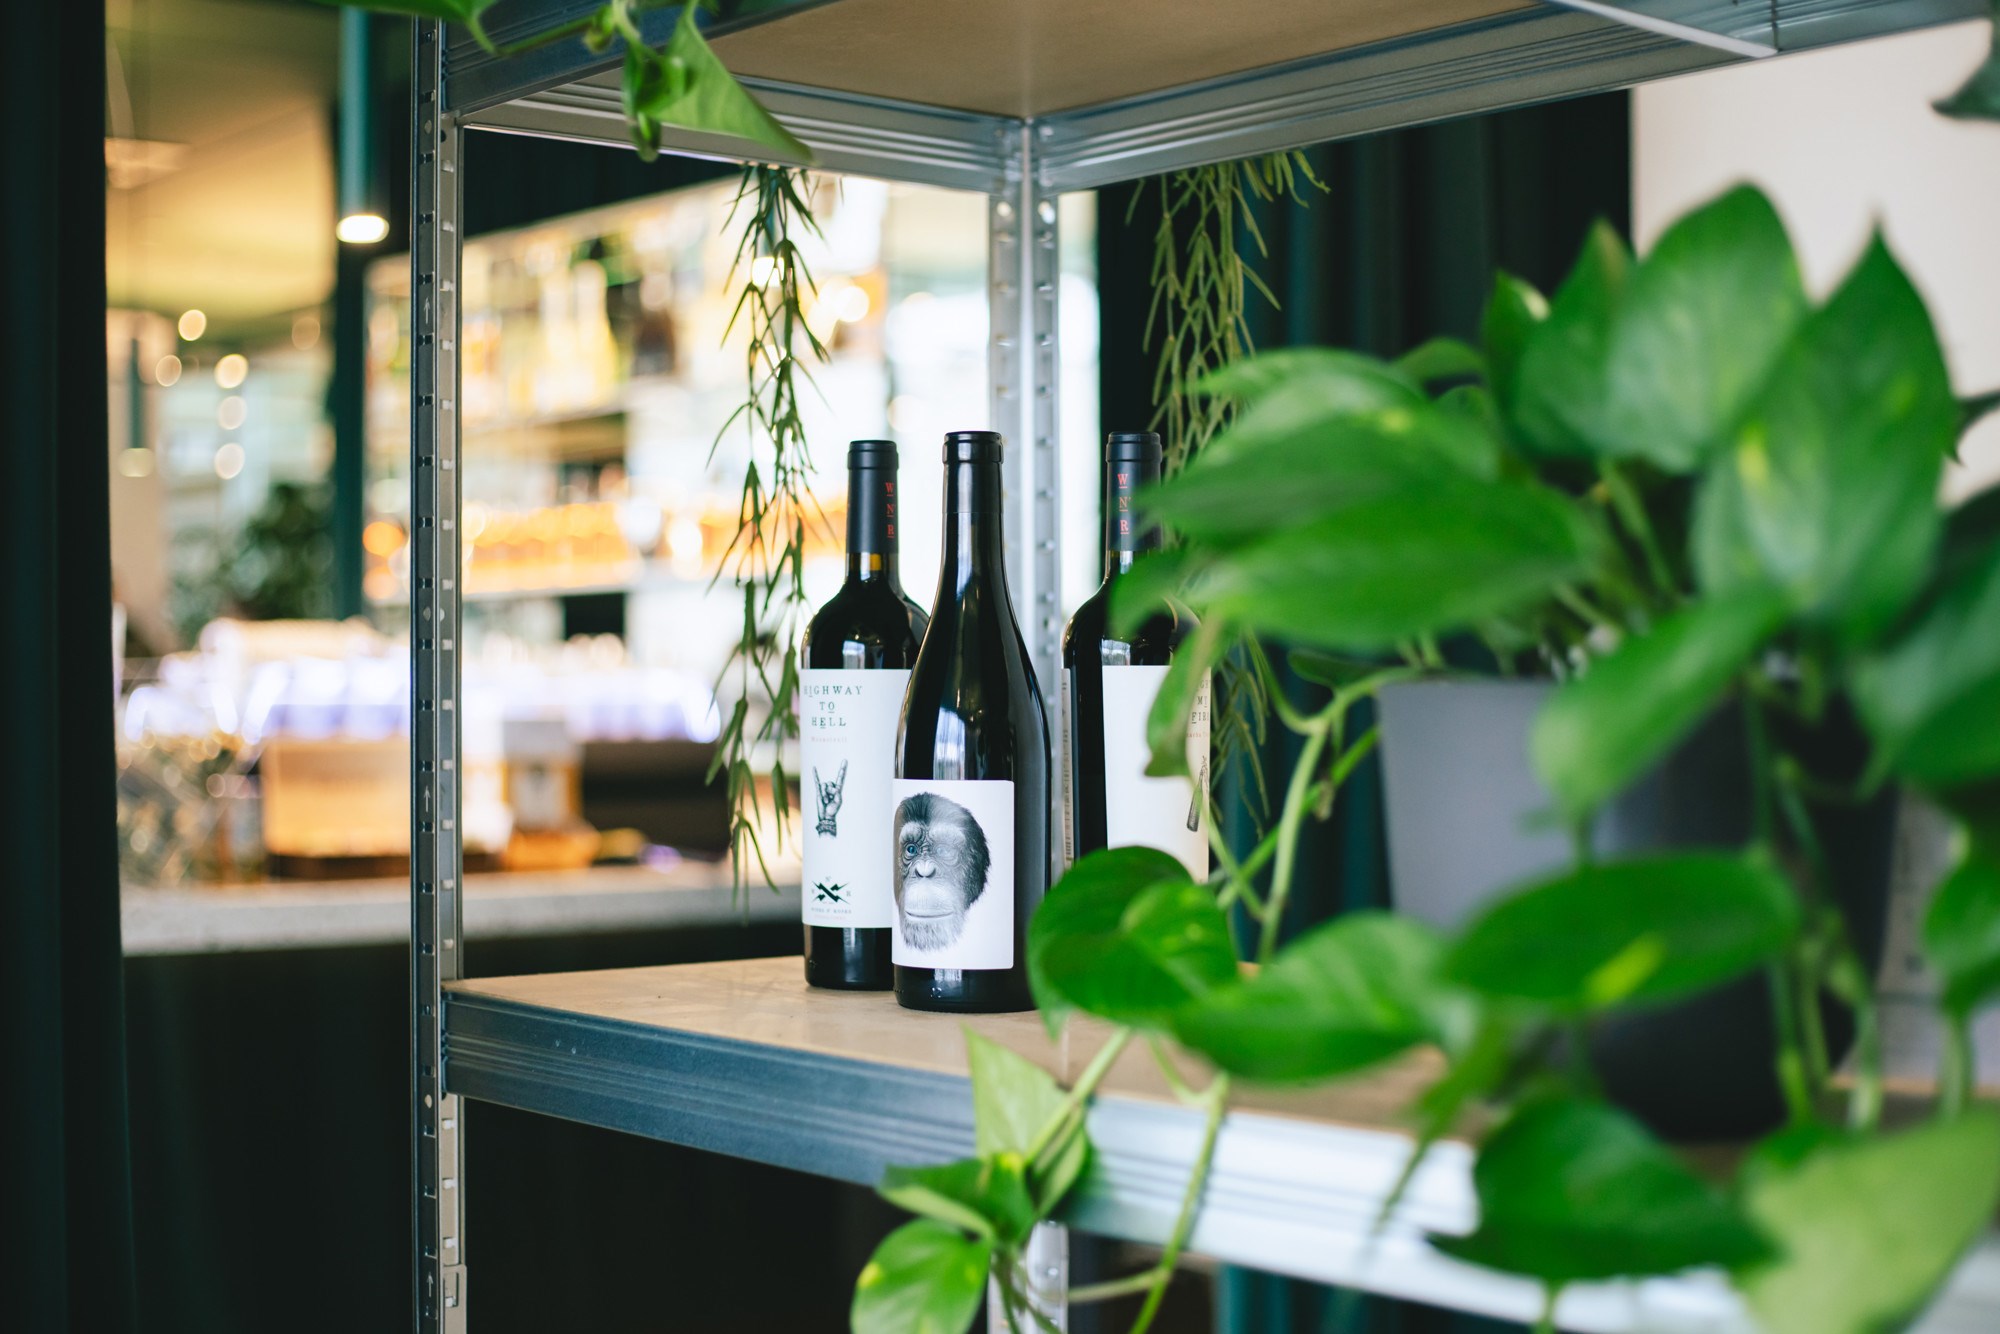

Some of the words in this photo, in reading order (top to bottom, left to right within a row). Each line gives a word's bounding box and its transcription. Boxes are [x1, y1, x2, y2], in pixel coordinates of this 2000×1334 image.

[1117, 473, 1129, 488] W
[885, 482, 894, 496] W
[1120, 519, 1129, 534] R
[803, 685, 862, 697] HIGHWAY
[819, 702, 835, 713] TO
[811, 717, 847, 728] HELL
